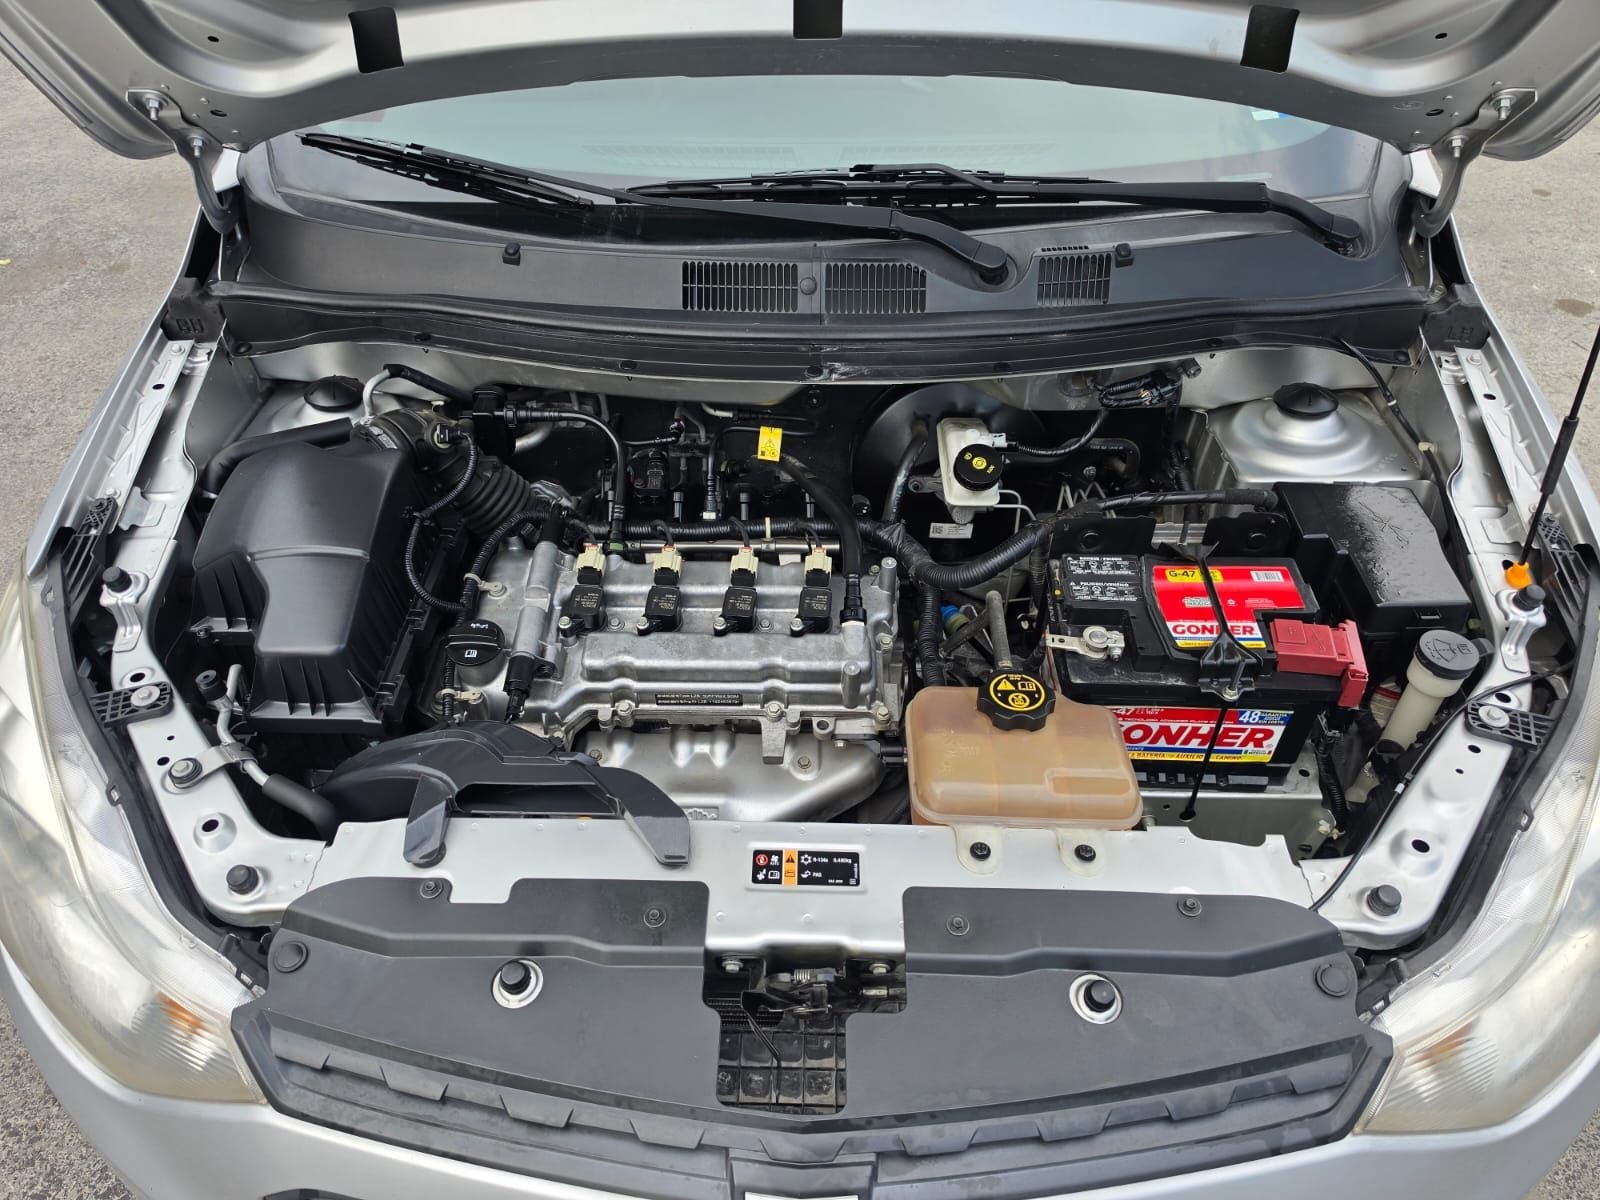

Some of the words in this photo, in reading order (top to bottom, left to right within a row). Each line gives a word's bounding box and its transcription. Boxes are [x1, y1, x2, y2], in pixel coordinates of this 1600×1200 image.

[1168, 570, 1196, 578] G-47
[1239, 711, 1260, 724] 48
[1119, 723, 1275, 749] ONHER
